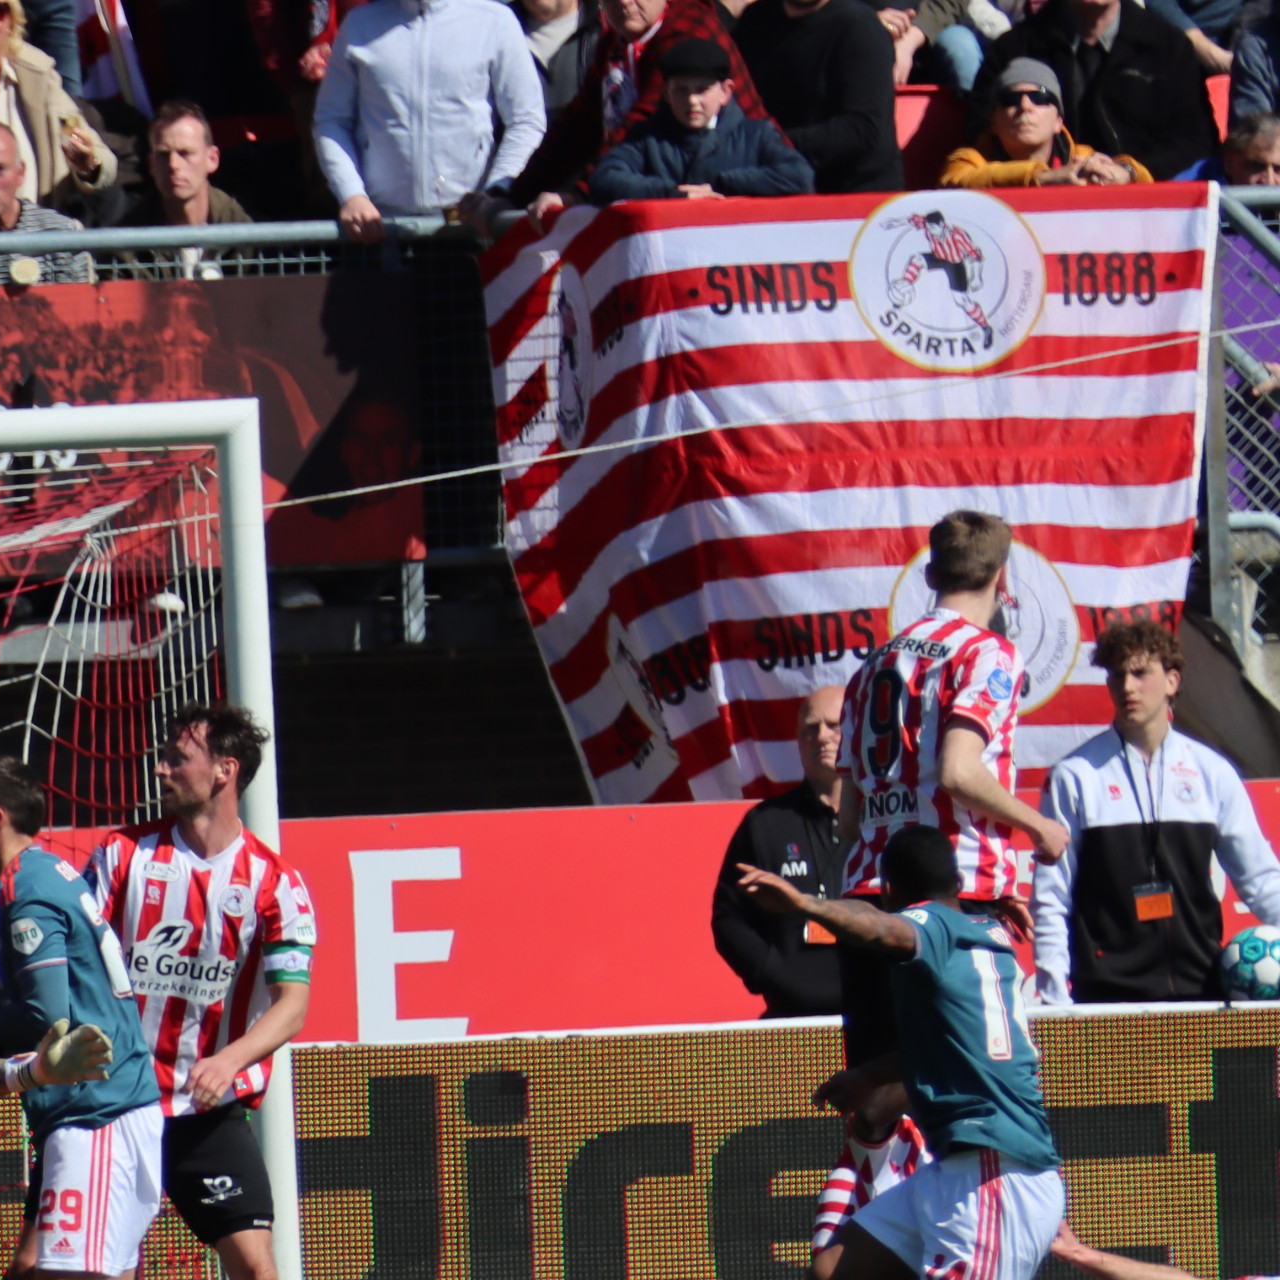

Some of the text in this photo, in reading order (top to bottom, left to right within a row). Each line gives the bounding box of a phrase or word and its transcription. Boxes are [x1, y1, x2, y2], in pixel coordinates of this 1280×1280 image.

[706, 250, 1157, 316] SINDS 1888
[878, 306, 978, 358] SPARTA
[754, 608, 876, 672] SINDS
[868, 668, 903, 778] 9
[780, 860, 807, 877] AM
[13, 926, 38, 944] TOTO
[39, 1189, 83, 1232] 29
